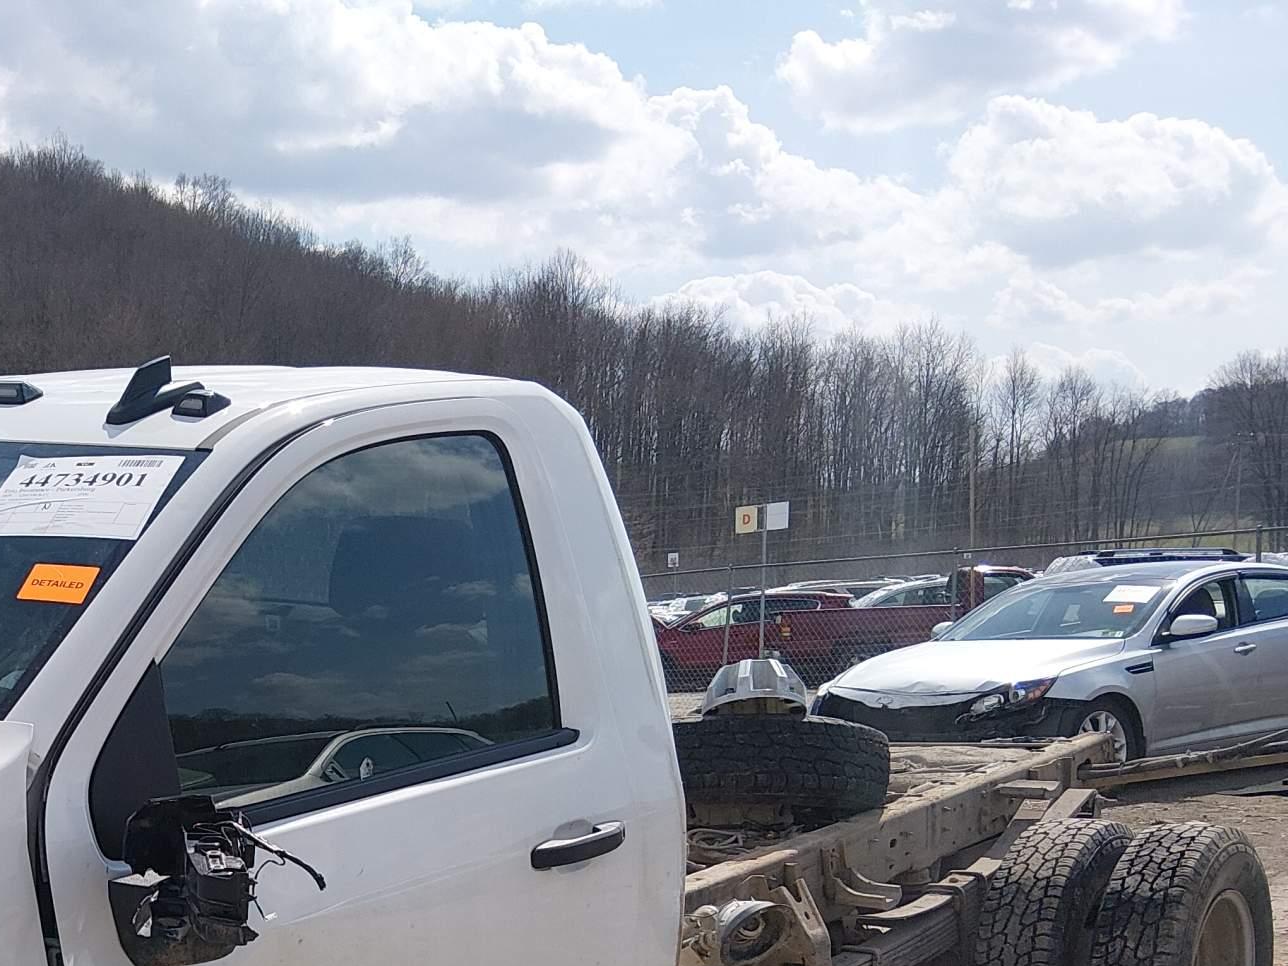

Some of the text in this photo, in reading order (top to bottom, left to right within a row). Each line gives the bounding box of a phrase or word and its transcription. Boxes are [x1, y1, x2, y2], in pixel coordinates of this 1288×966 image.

[20, 472, 148, 487] 44734901
[743, 514, 751, 525] D
[31, 578, 84, 590] DETAILED
